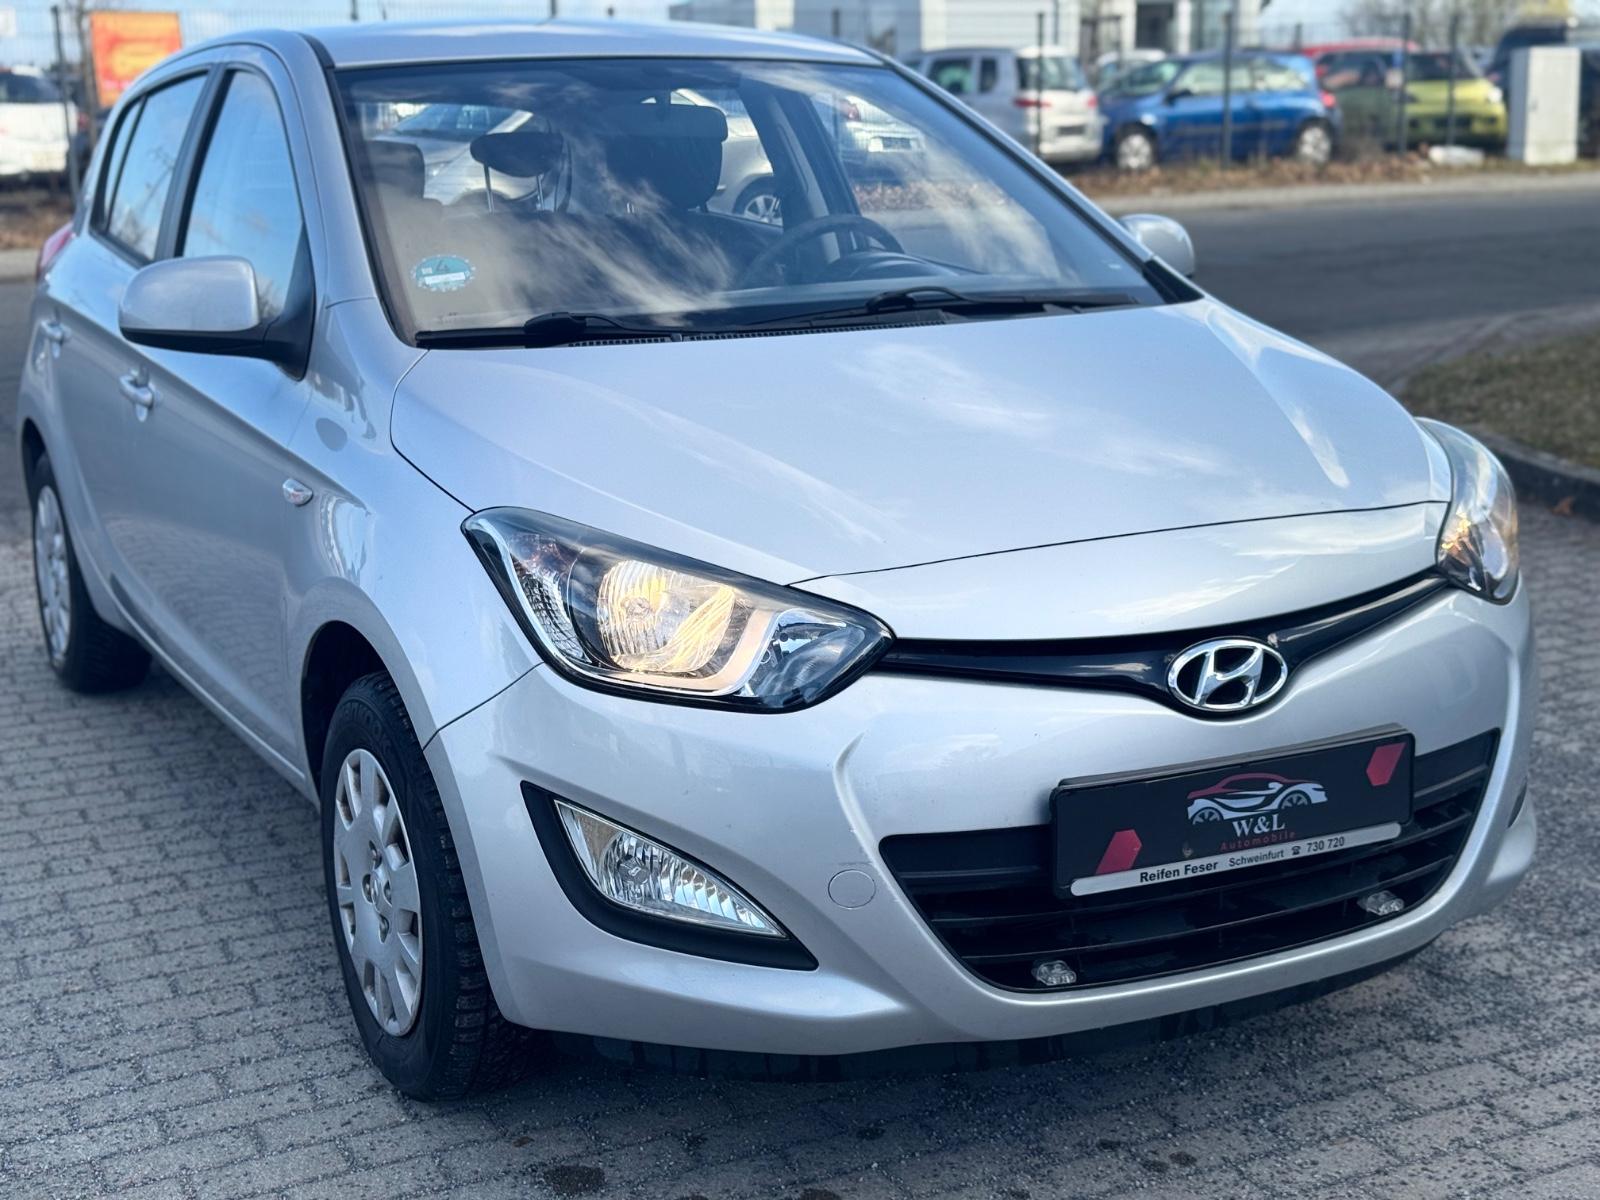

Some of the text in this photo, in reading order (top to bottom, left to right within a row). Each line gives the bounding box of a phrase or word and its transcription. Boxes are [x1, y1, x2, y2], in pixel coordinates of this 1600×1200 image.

[1232, 813, 1286, 838] W&L
[1220, 830, 1297, 852] Automobile
[1139, 836, 1345, 883] Reifen Feser Schweinfurt 730 720
